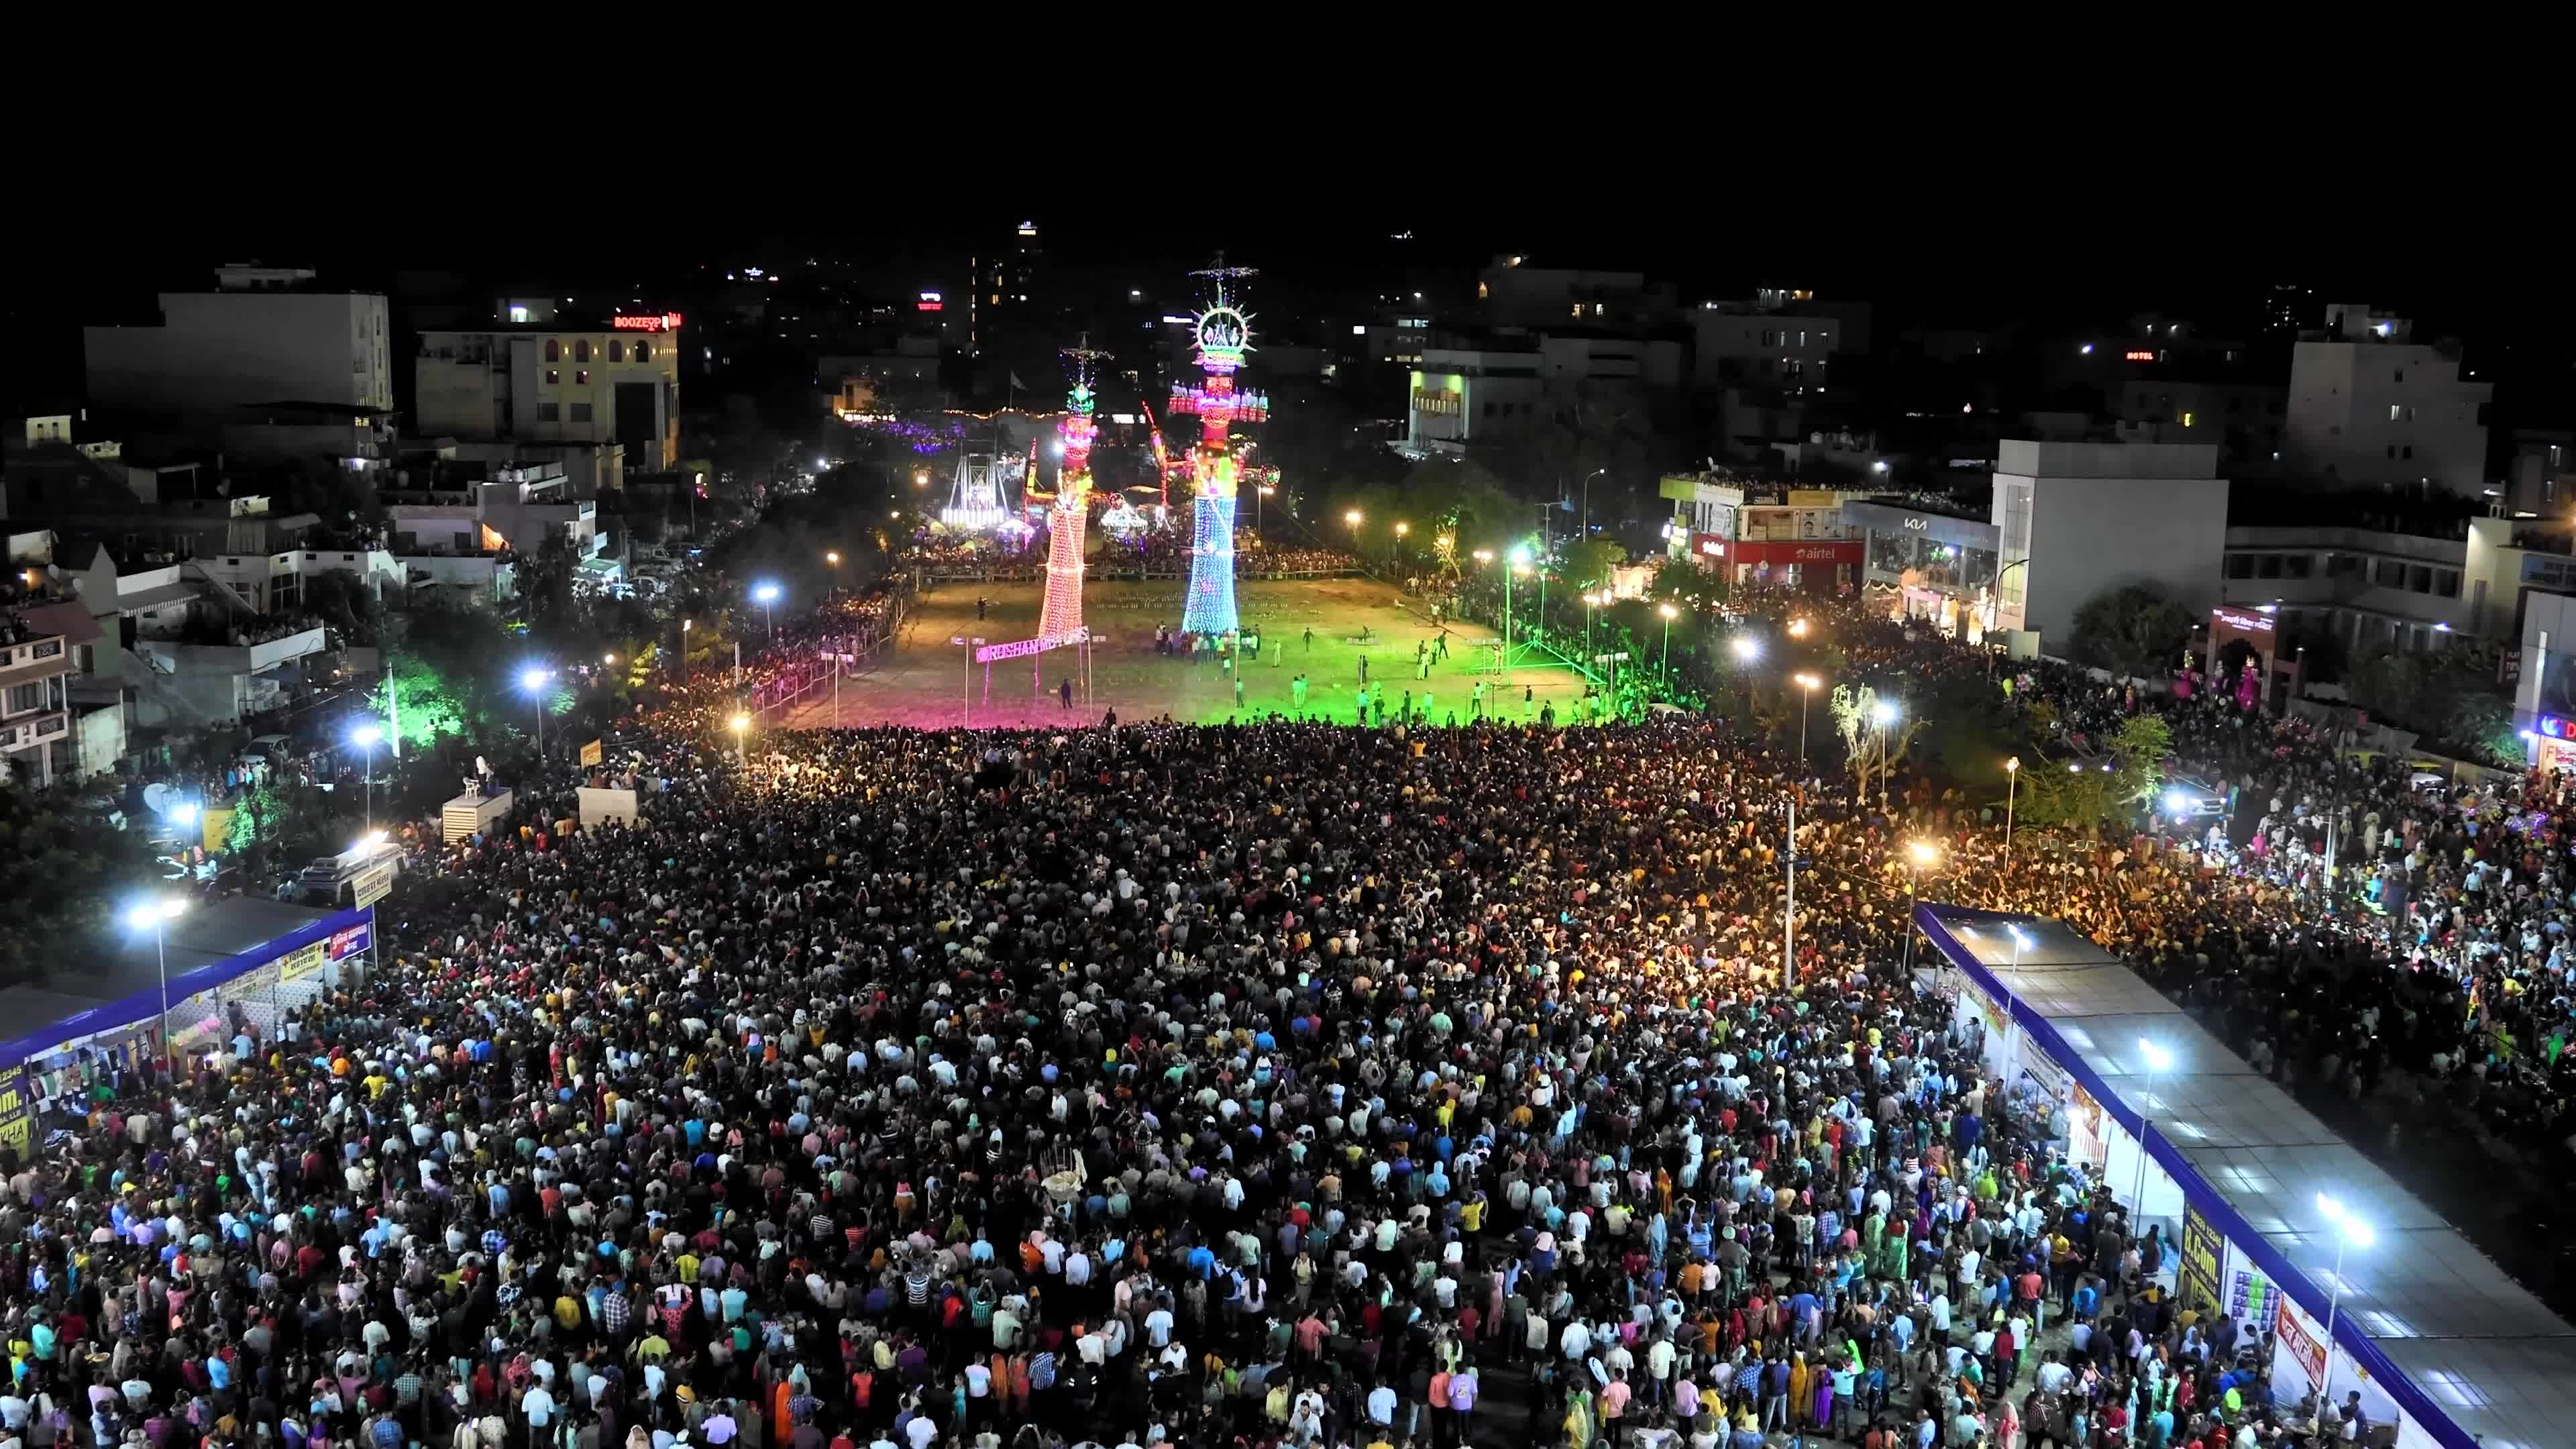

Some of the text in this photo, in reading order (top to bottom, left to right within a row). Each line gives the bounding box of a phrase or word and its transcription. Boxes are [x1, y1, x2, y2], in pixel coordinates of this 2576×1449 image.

[2127, 352, 2153, 360] HOTEL
[1807, 547, 1835, 559] airtel
[989, 640, 1036, 661] ROSHAN
[2184, 1224, 2218, 1285] B.Com.
